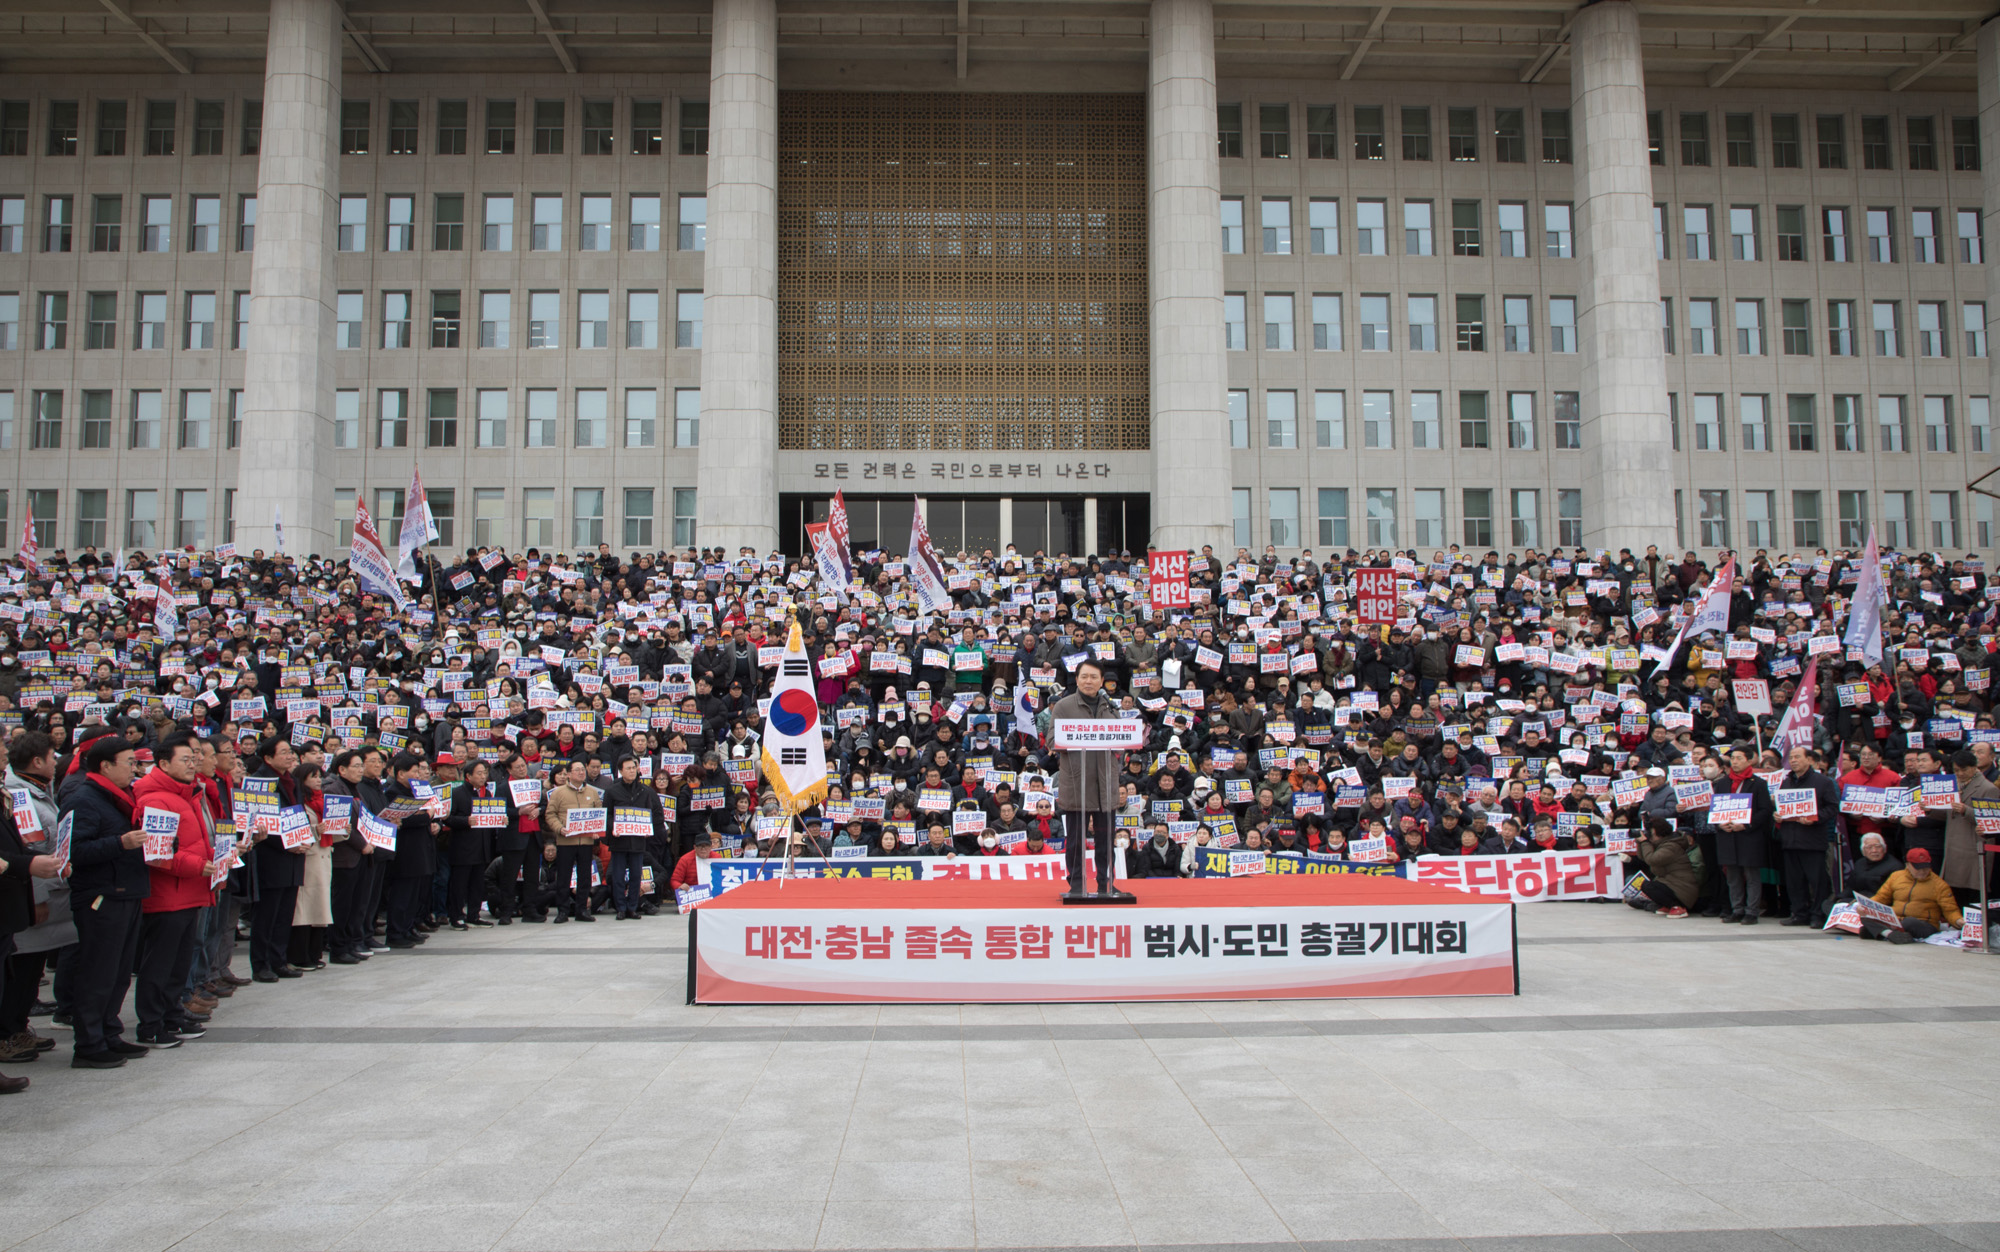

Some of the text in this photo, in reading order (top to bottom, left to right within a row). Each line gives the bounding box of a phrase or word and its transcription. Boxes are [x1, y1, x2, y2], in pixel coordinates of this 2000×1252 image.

[814, 463, 1111, 480] 모든 권력은 국민으로부터 나온다
[360, 557, 386, 581] 강제합병
[1152, 555, 1186, 579] 서산
[1359, 573, 1394, 595] 서산
[1153, 581, 1187, 605] 태안
[1360, 599, 1395, 620] 태안
[612, 674, 637, 683] 결사 반대!
[1735, 683, 1758, 700] 천안갑
[673, 725, 701, 733] 중단하라
[1930, 722, 1961, 731] 강제합병
[382, 735, 392, 744] 주민
[1932, 731, 1959, 739] 결사반대
[664, 756, 675, 764] 주민
[739, 770, 754, 780] 반대!
[1671, 769, 1684, 777] 주민
[1226, 782, 1235, 791] 주민
[1677, 785, 1692, 796] 충남·대전
[1921, 780, 1954, 793] 강제합병
[256, 793, 267, 804] 이양
[1338, 789, 1366, 797] 강제합병
[1778, 791, 1813, 801] 충남·대전 졸속 통합
[1846, 791, 1885, 803] 강제합병
[692, 799, 724, 810] 중단하라
[1295, 796, 1323, 805] 강제합병
[1336, 798, 1364, 806] 결사반대
[1616, 793, 1631, 805] 결사
[1695, 794, 1712, 805] 반대!
[1713, 798, 1749, 811] 강제합병
[1922, 794, 1955, 807] 결사반대
[326, 801, 351, 818] 강제합병
[919, 801, 949, 809] 중단하라
[1154, 802, 1164, 812] 주민
[1295, 805, 1322, 815] 결사반대
[1779, 802, 1813, 816] 결사 반대!
[1842, 802, 1882, 813] 결사반대
[569, 811, 581, 819] 주민
[853, 807, 883, 816] 결사 반대!
[955, 812, 964, 820] 주민
[1711, 810, 1747, 822] 결사반대
[147, 815, 158, 828] 주민
[236, 814, 279, 832] 중하라
[280, 810, 309, 831] 강제합병
[325, 818, 348, 831] 결사반대
[1559, 815, 1569, 824] 주민
[568, 820, 605, 834] 정치쇼 중단하라!
[615, 823, 650, 834] 중단하라
[759, 829, 772, 838] 결사
[1352, 842, 1368, 850] 충남·대전
[1608, 841, 1622, 851] 결사
[1352, 849, 1385, 861] 결사 반대!
[1232, 861, 1264, 875] 결사 반대!
[745, 925, 894, 960] 대전·충남
[905, 925, 973, 960] 졸속
[985, 925, 1054, 960] 통합
[1065, 925, 1131, 959] 반대
[1300, 920, 1467, 957] 총궐기대회
